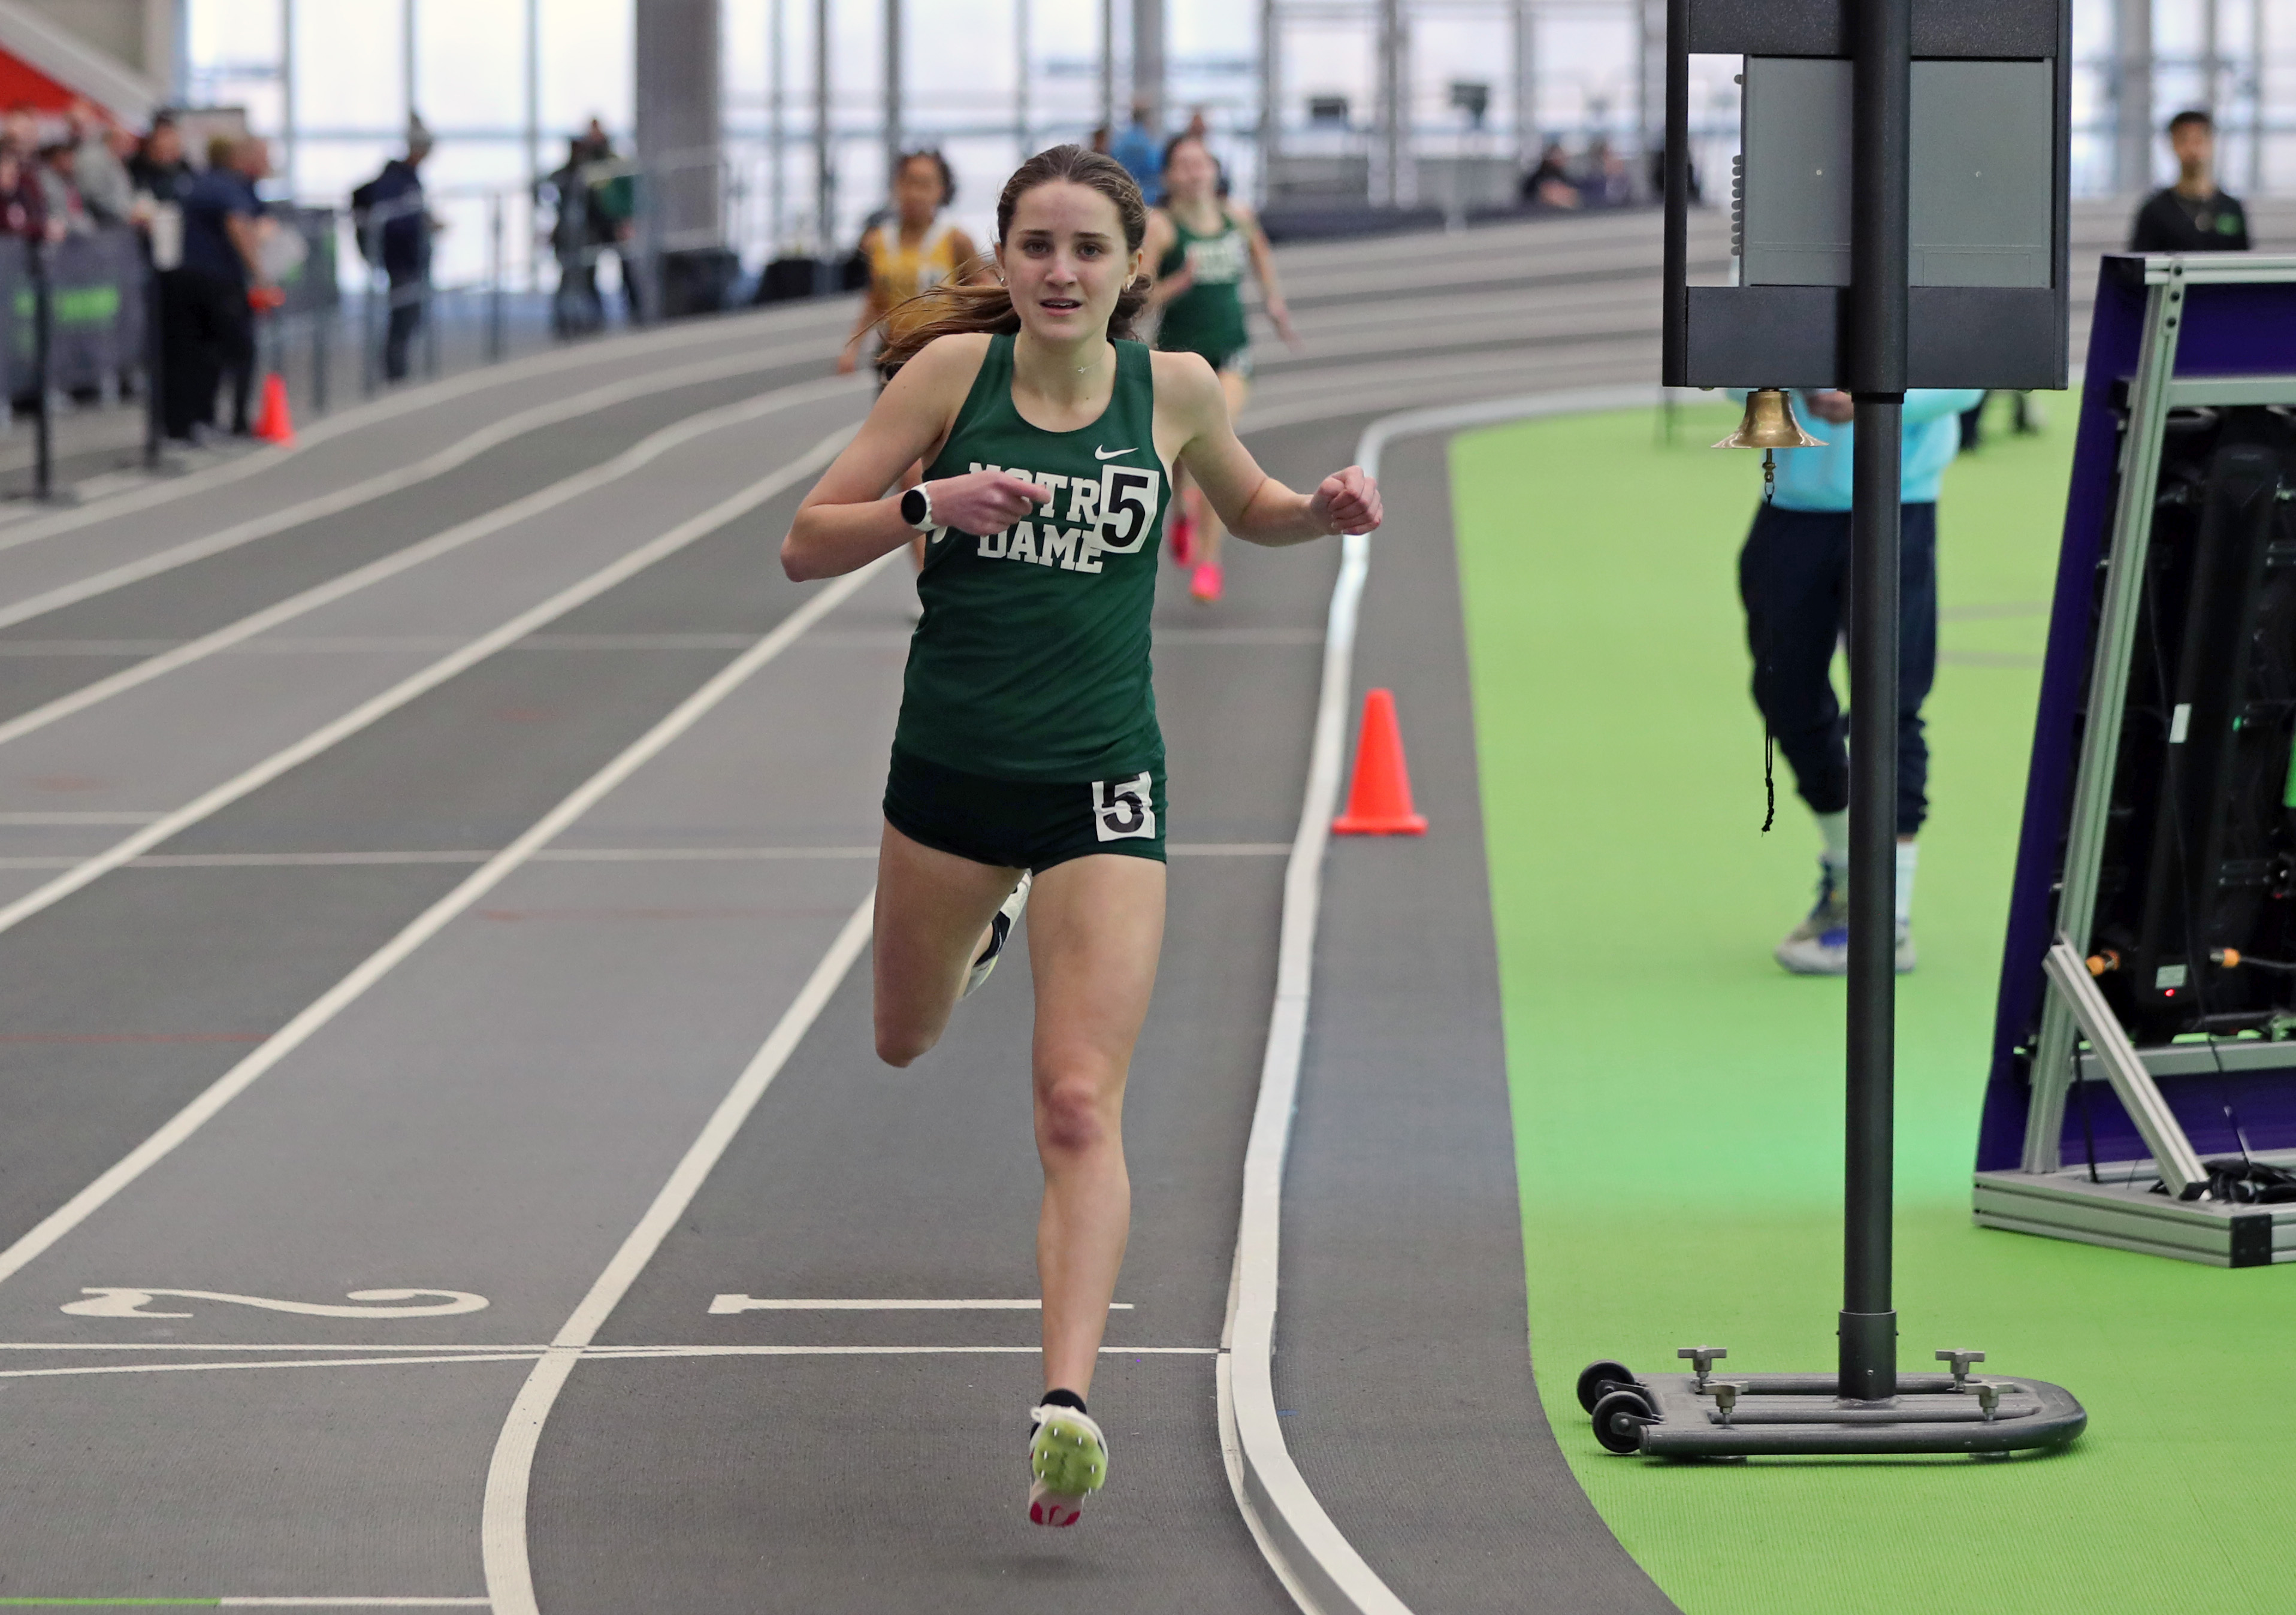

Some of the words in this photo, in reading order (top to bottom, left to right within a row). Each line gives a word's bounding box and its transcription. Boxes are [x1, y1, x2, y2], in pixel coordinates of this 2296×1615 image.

[1102, 473, 1149, 548] 5
[977, 521, 1104, 574] DAME
[1101, 772, 1144, 833] 5
[59, 1287, 490, 1318] 2
